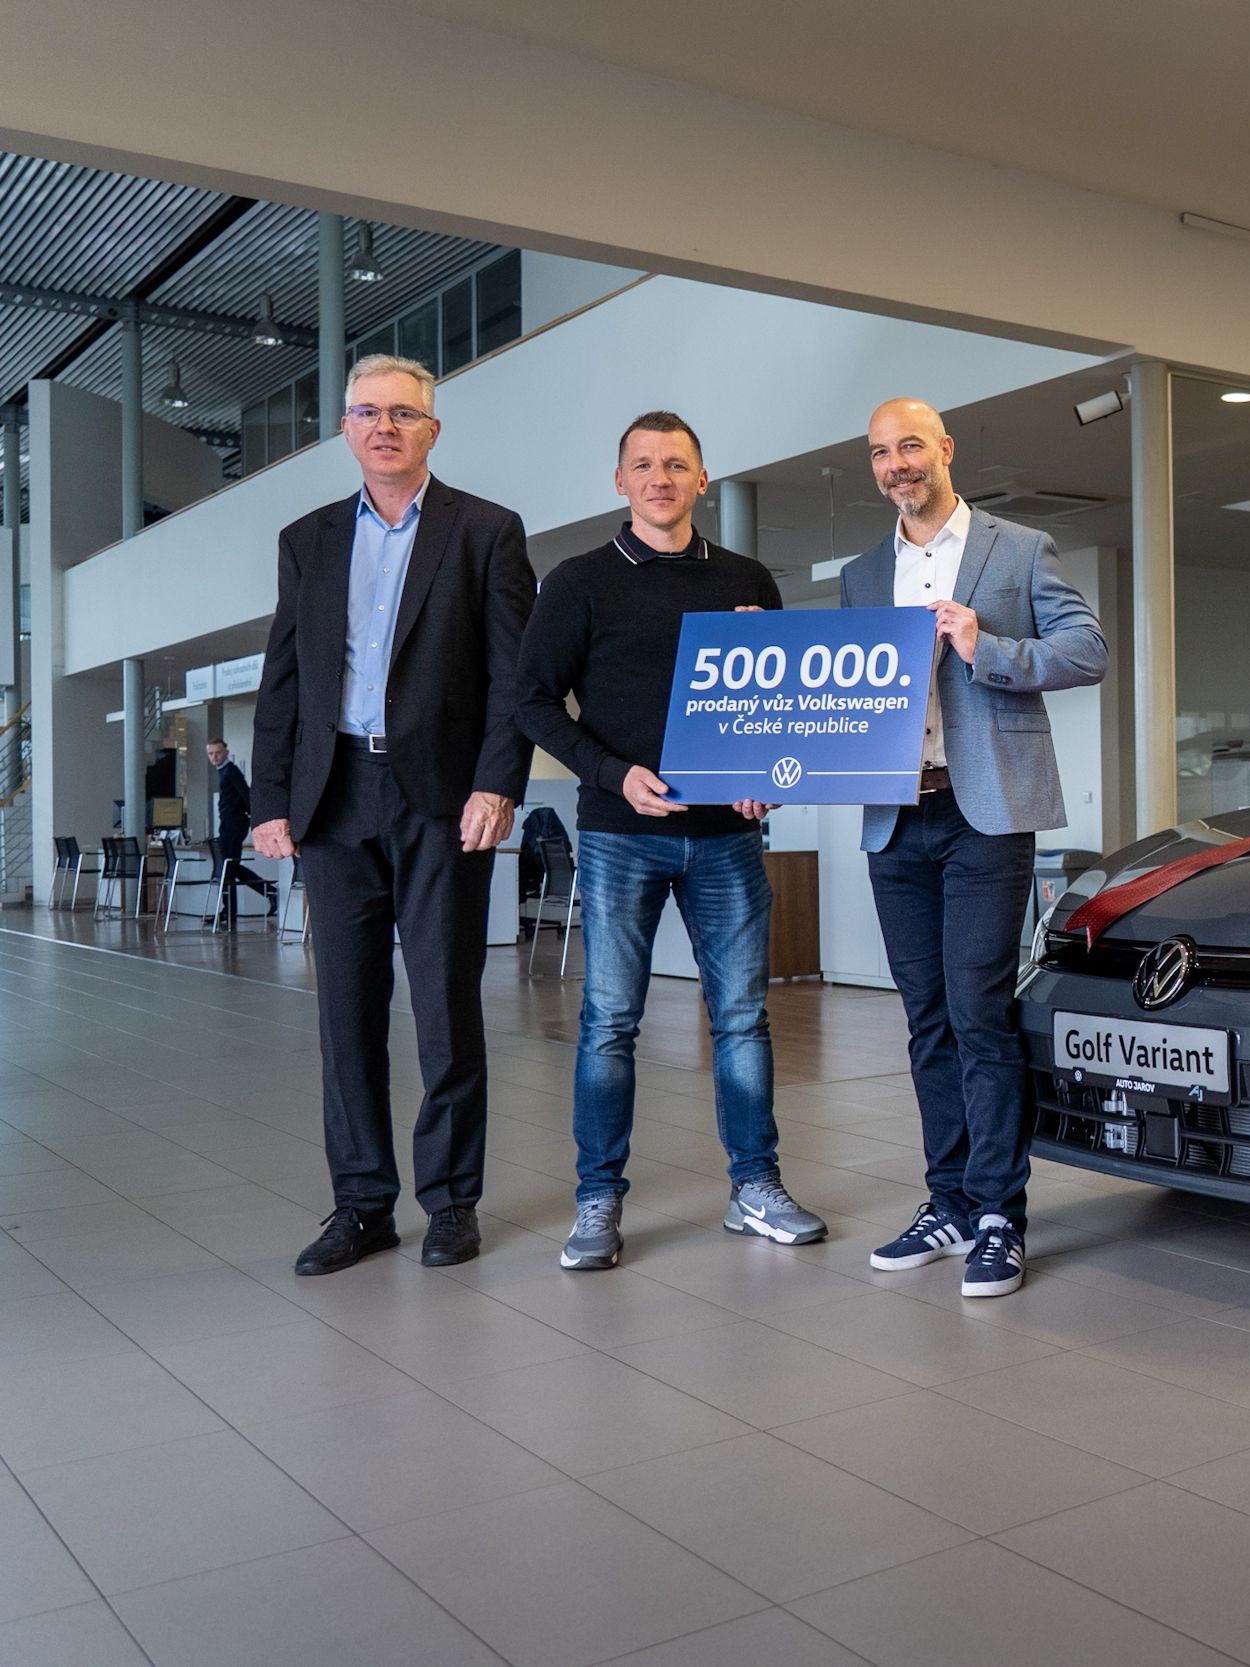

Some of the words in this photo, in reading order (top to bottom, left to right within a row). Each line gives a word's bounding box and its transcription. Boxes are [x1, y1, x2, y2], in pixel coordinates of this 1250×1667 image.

[690, 646, 786, 690] 500
[800, 643, 911, 688] 000.
[686, 695, 759, 715] prodaný
[763, 693, 793, 711] vůz
[798, 693, 908, 713] Volkswagen
[718, 722, 728, 735] v
[733, 714, 782, 734] České
[787, 716, 868, 737] republice
[1065, 1029, 1112, 1063] Golf
[1118, 1034, 1215, 1075] Variant
[1115, 1078, 1133, 1090] AUTO
[1133, 1081, 1155, 1093] JAROV
